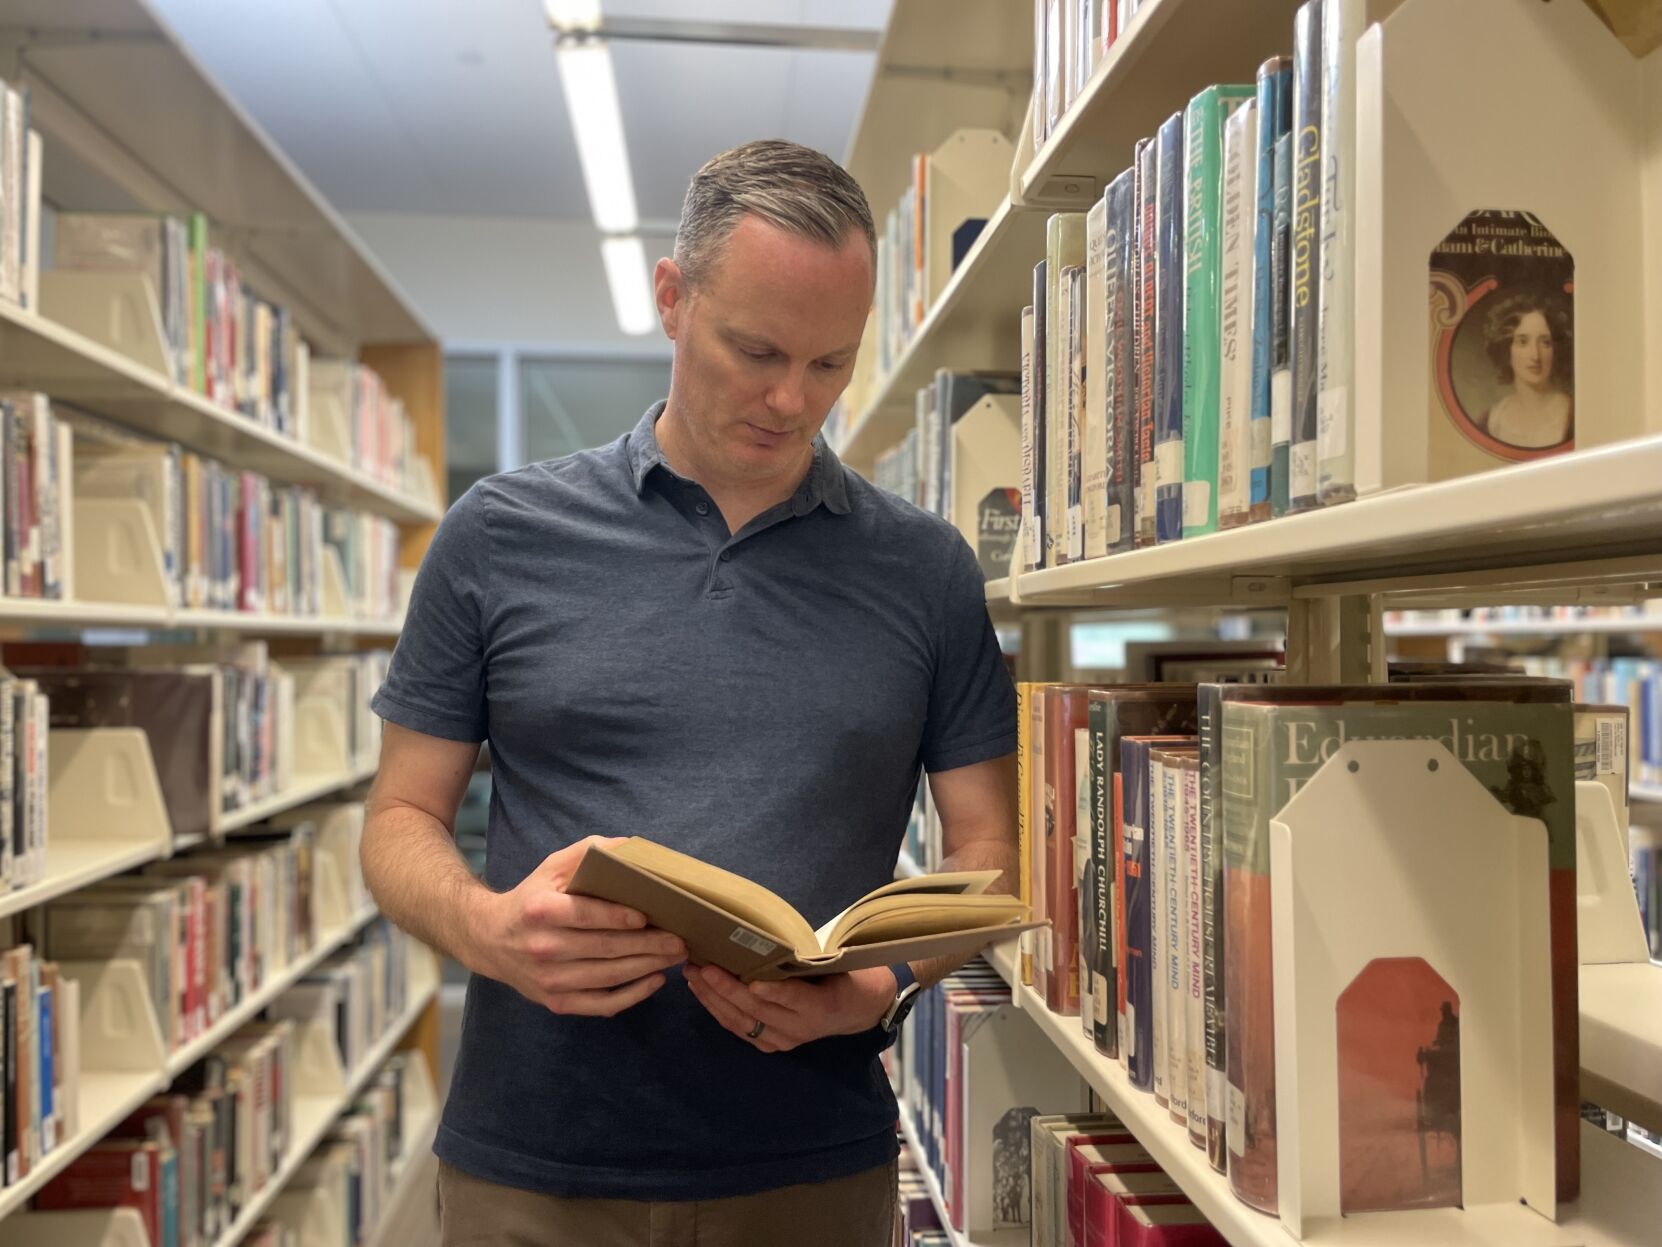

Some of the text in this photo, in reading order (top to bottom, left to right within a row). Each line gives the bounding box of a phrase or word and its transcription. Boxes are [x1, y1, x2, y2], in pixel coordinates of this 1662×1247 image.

[1187, 122, 1204, 272] THE BRITISH
[1294, 124, 1320, 309] Gladstone
[1472, 223, 1527, 237] Intimate
[1106, 229, 1117, 481] QUEEN VICTORIA
[1141, 420, 1155, 461] Taste
[1200, 711, 1212, 750] THE
[1283, 718, 1531, 766] Eddian
[1188, 770, 1196, 799] THE
[1201, 761, 1213, 865] COUNTRY
[1096, 731, 1107, 952] LADY RANDOLPH CHURCHILL
[1204, 875, 1215, 942] HOUSE
[1171, 955, 1179, 990] MIND
[1191, 961, 1200, 999] MIND
